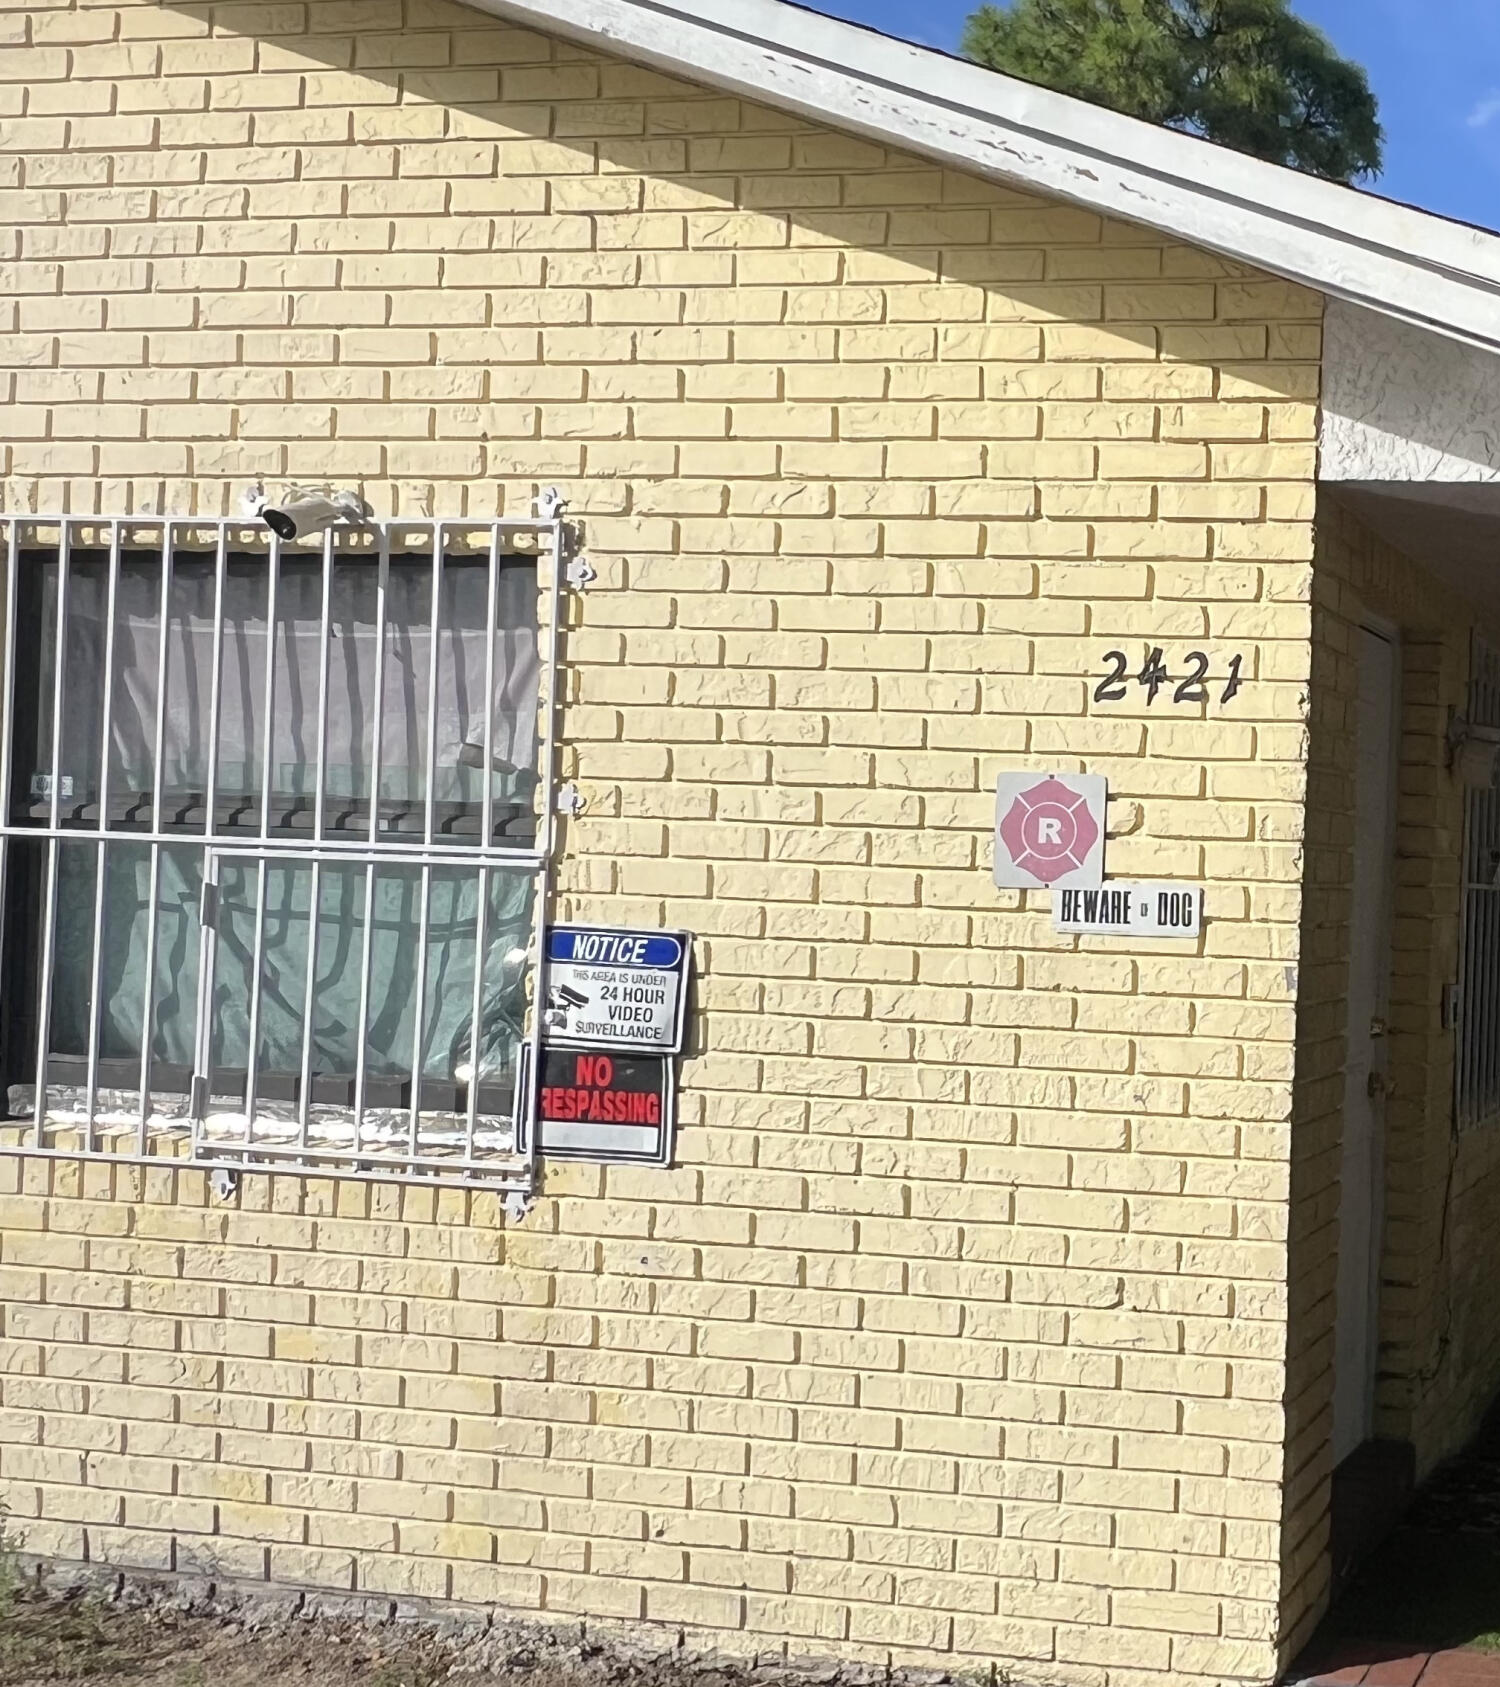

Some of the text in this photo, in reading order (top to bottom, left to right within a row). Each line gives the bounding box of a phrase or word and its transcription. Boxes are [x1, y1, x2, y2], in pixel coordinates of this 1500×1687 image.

[1094, 647, 1242, 706] 2421
[1037, 816, 1063, 845] R
[1060, 889, 1132, 925] BEWARE
[1157, 891, 1193, 928] DOG
[572, 934, 649, 964] NOTICE
[590, 971, 616, 983] AREA
[619, 973, 629, 984] IS
[631, 974, 667, 987] UNDER
[600, 985, 666, 1005] 24 HOUR
[608, 1005, 653, 1023] VIDEO
[575, 1020, 663, 1040] SURVEILLANCE
[575, 1055, 613, 1087] NO
[541, 1086, 659, 1124] RESPASSING
